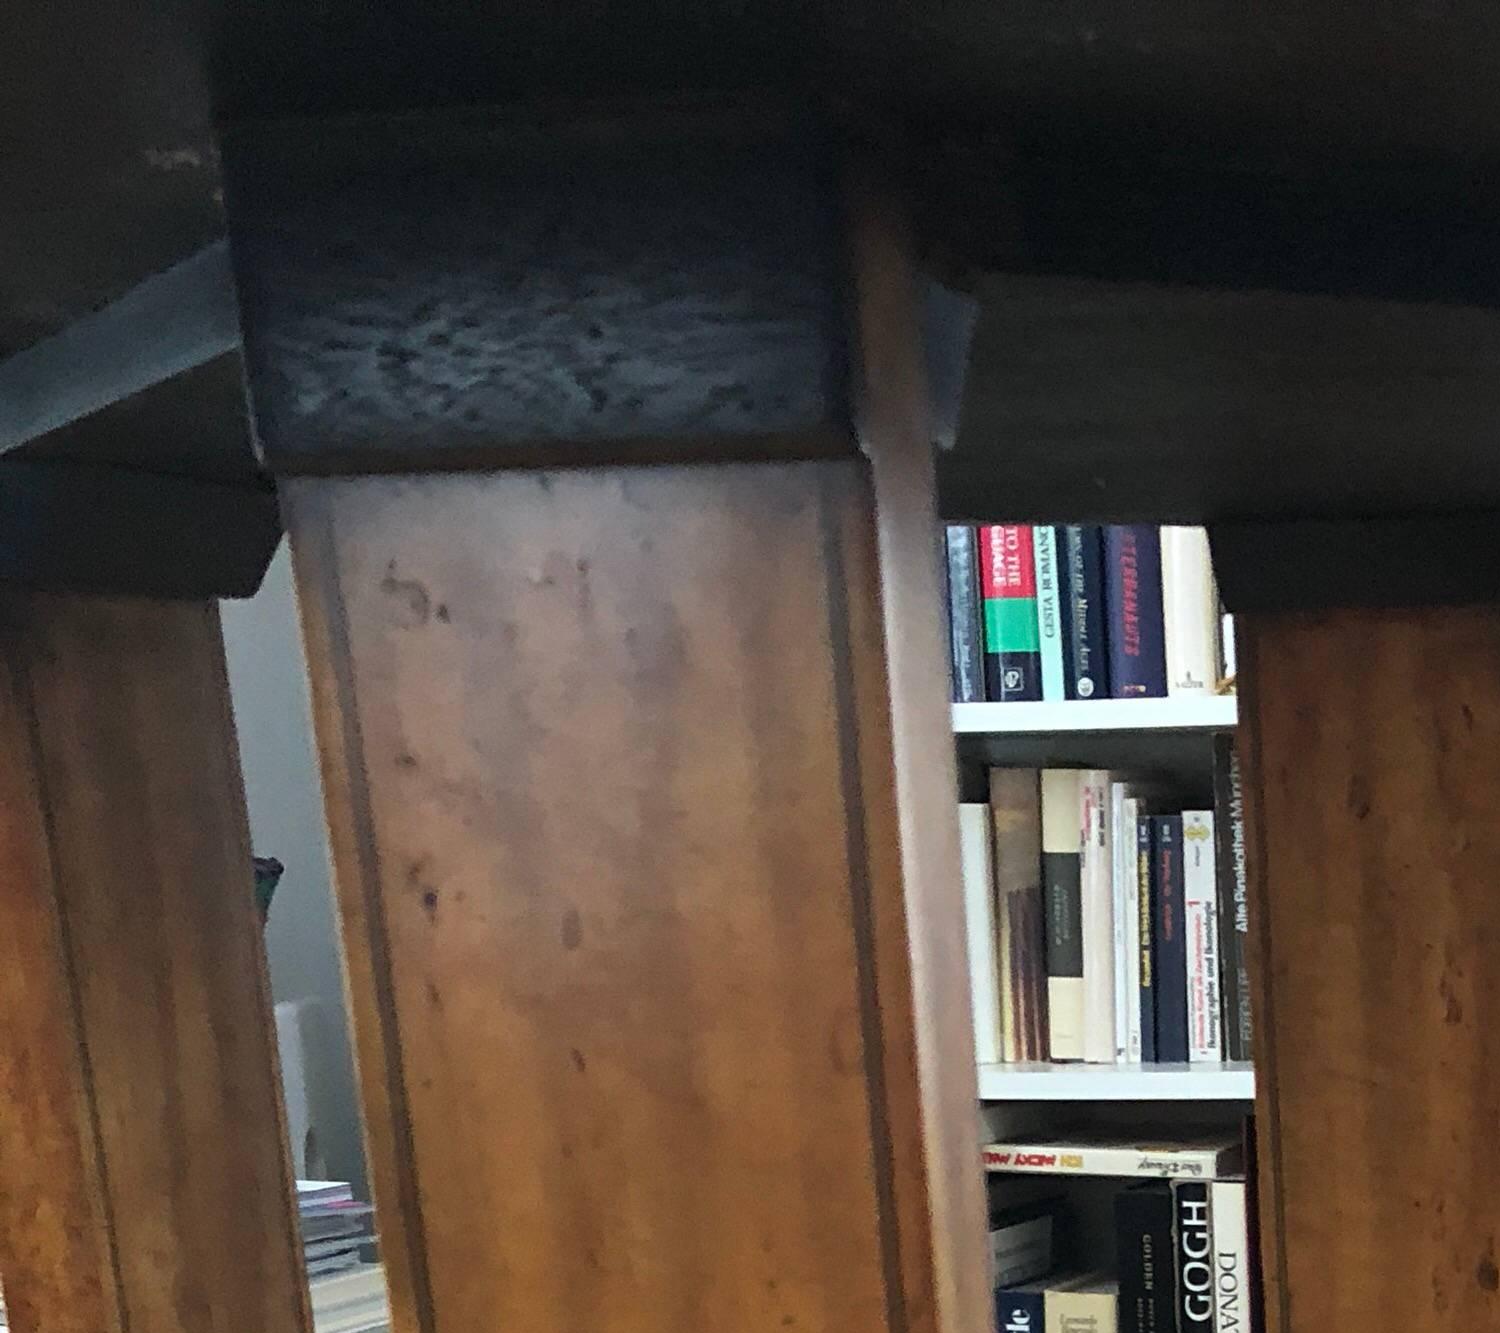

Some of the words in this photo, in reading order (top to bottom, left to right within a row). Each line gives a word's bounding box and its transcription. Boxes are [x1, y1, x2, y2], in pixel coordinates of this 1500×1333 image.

[1007, 555, 1021, 586] THE
[1043, 597, 1055, 638] GESTA
[1230, 821, 1247, 903] Pinakothek
[1203, 902, 1216, 956] Ikonologie
[1234, 904, 1249, 934] Alte
[1205, 957, 1215, 979] und
[1206, 981, 1218, 1049] Ikonographie
[1142, 1233, 1154, 1291] GOLDEN
[1182, 1201, 1212, 1322] GOGH
